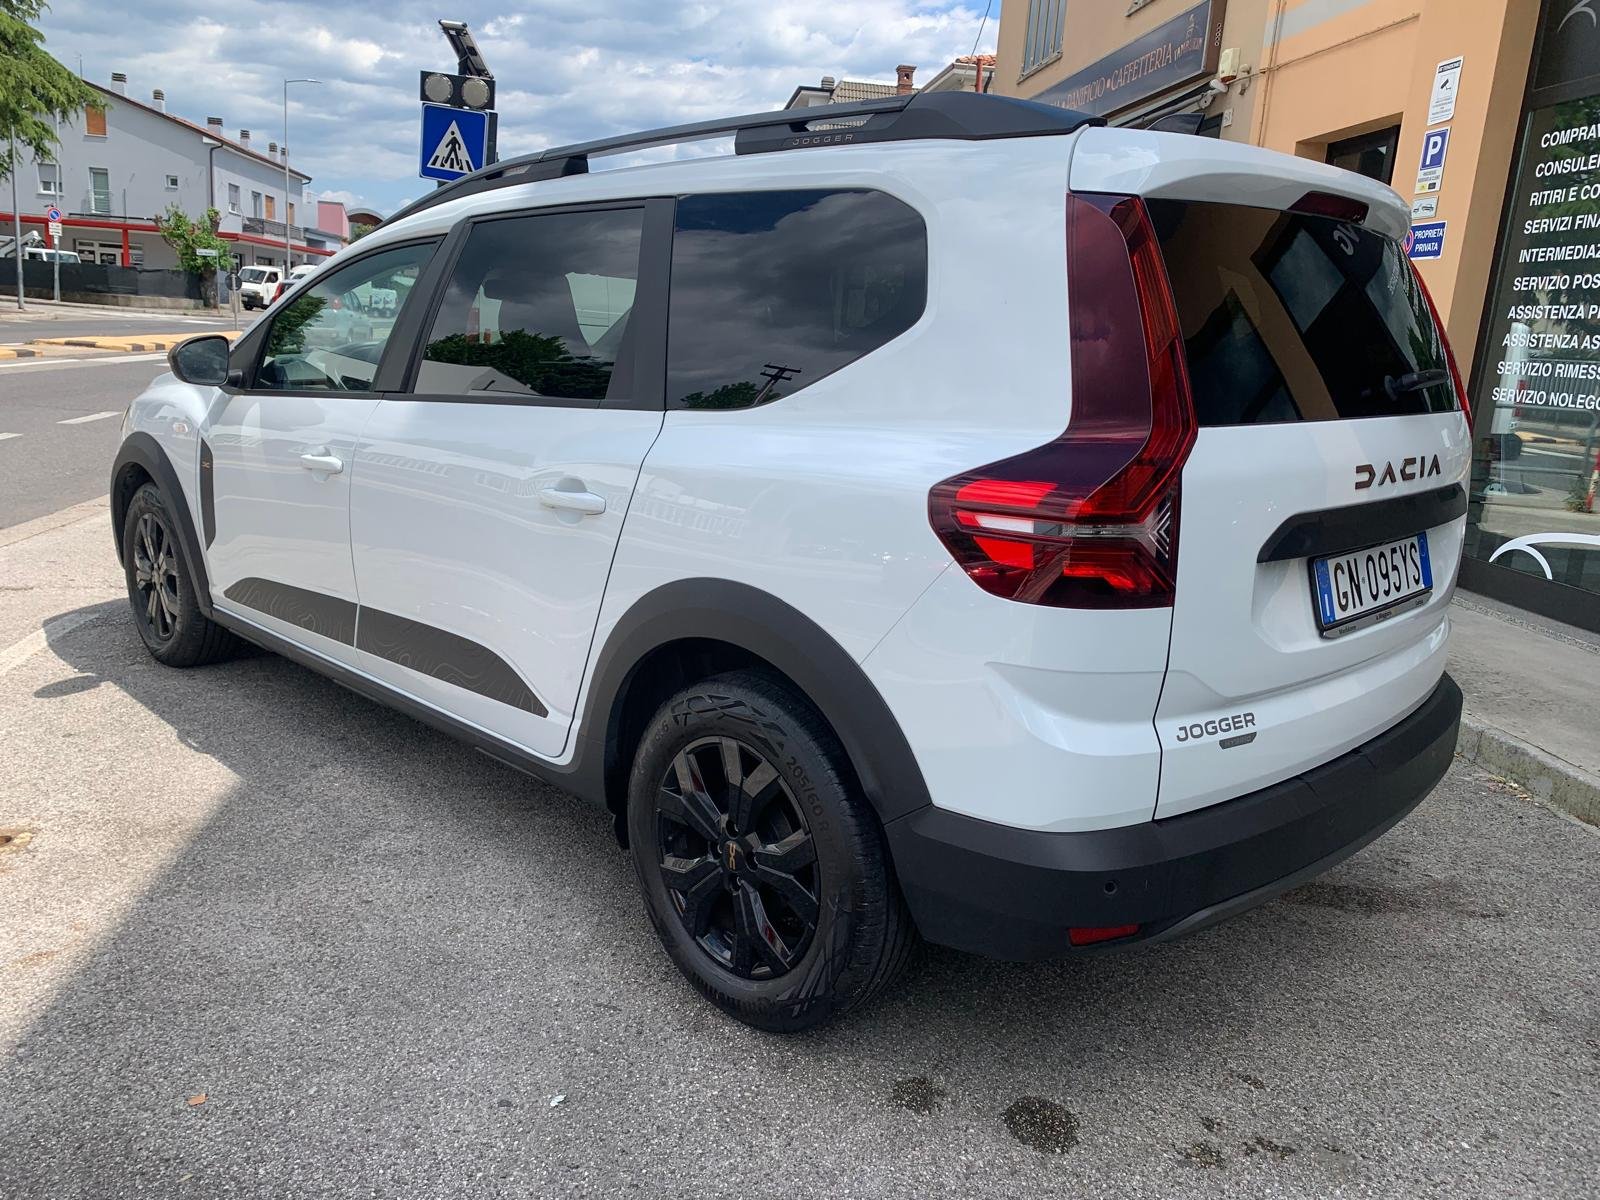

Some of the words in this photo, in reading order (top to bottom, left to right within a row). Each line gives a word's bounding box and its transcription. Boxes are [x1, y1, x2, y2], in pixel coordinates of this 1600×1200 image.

[792, 134, 854, 146] JOGGER
[1541, 123, 1600, 148] COMPRA
[1426, 136, 1442, 165] P
[1529, 188, 1567, 207] RITIRI
[1567, 186, 1578, 202] E
[1523, 216, 1573, 235] SERVIZI
[1414, 242, 1439, 253] PRIVATA
[1513, 275, 1570, 291] SERVIZIO
[1507, 304, 1585, 320] ASSISTENZA
[1502, 332, 1579, 349] ASSISTENZA
[1496, 360, 1552, 376] SERVIZIO
[1491, 387, 1547, 404] SERVIZIO
[1355, 454, 1441, 490] DACIA
[1176, 711, 1257, 742] JOGGER
